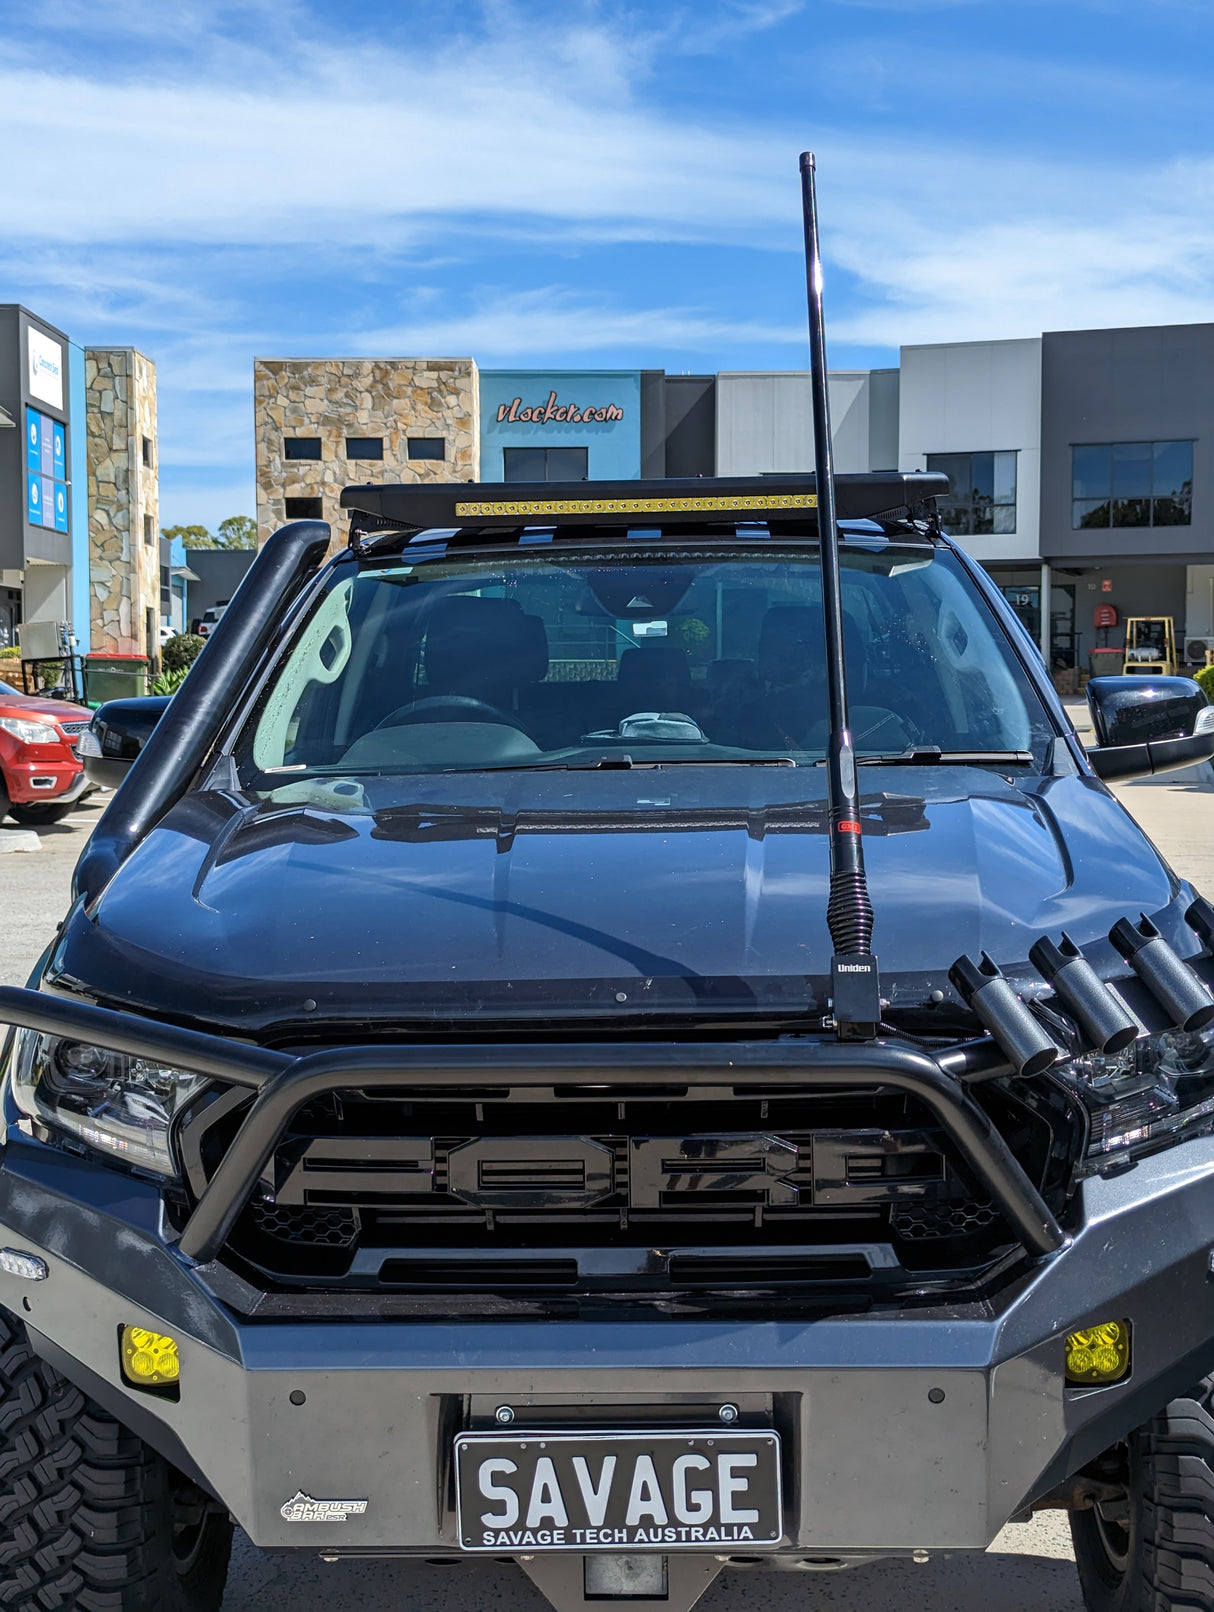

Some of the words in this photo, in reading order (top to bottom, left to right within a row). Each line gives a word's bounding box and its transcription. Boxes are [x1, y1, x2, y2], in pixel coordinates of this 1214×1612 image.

[1015, 594, 1029, 606] 19
[838, 964, 871, 973] Uniden
[478, 1453, 760, 1529] SAVAGE
[293, 1502, 366, 1513] AMBUSH
[291, 1511, 324, 1520] BAR
[482, 1530, 565, 1545] SAVAGE
[572, 1528, 628, 1544] TECH
[634, 1526, 754, 1543] AUSTRALIA
